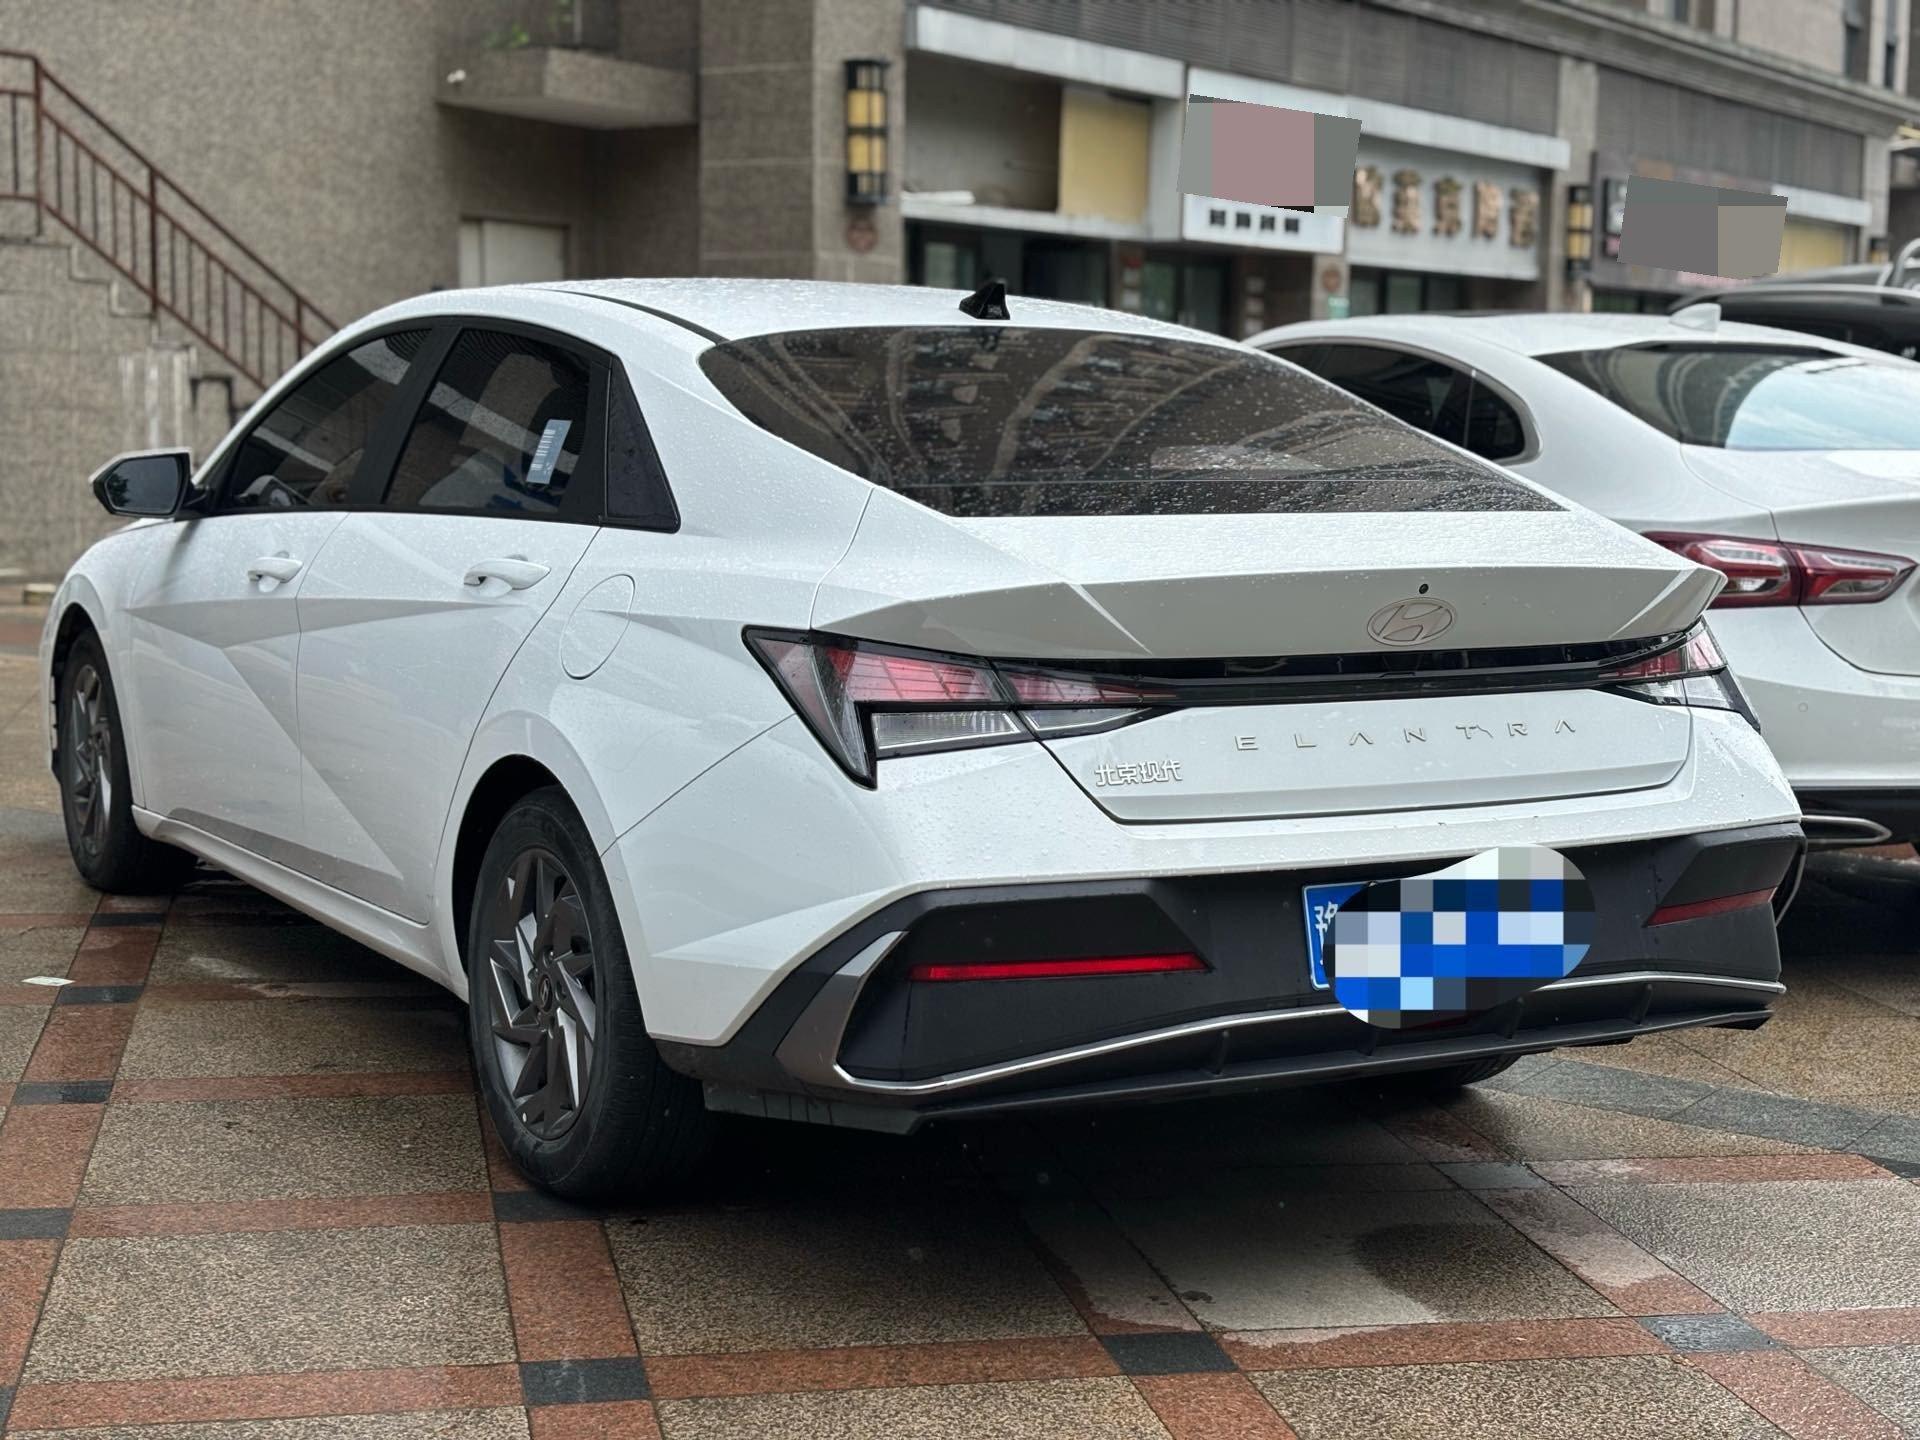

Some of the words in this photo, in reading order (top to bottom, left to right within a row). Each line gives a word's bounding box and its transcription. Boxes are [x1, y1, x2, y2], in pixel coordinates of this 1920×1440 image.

[1235, 719, 1576, 751] ELANTRA
[1095, 759, 1182, 786] 北京现代
